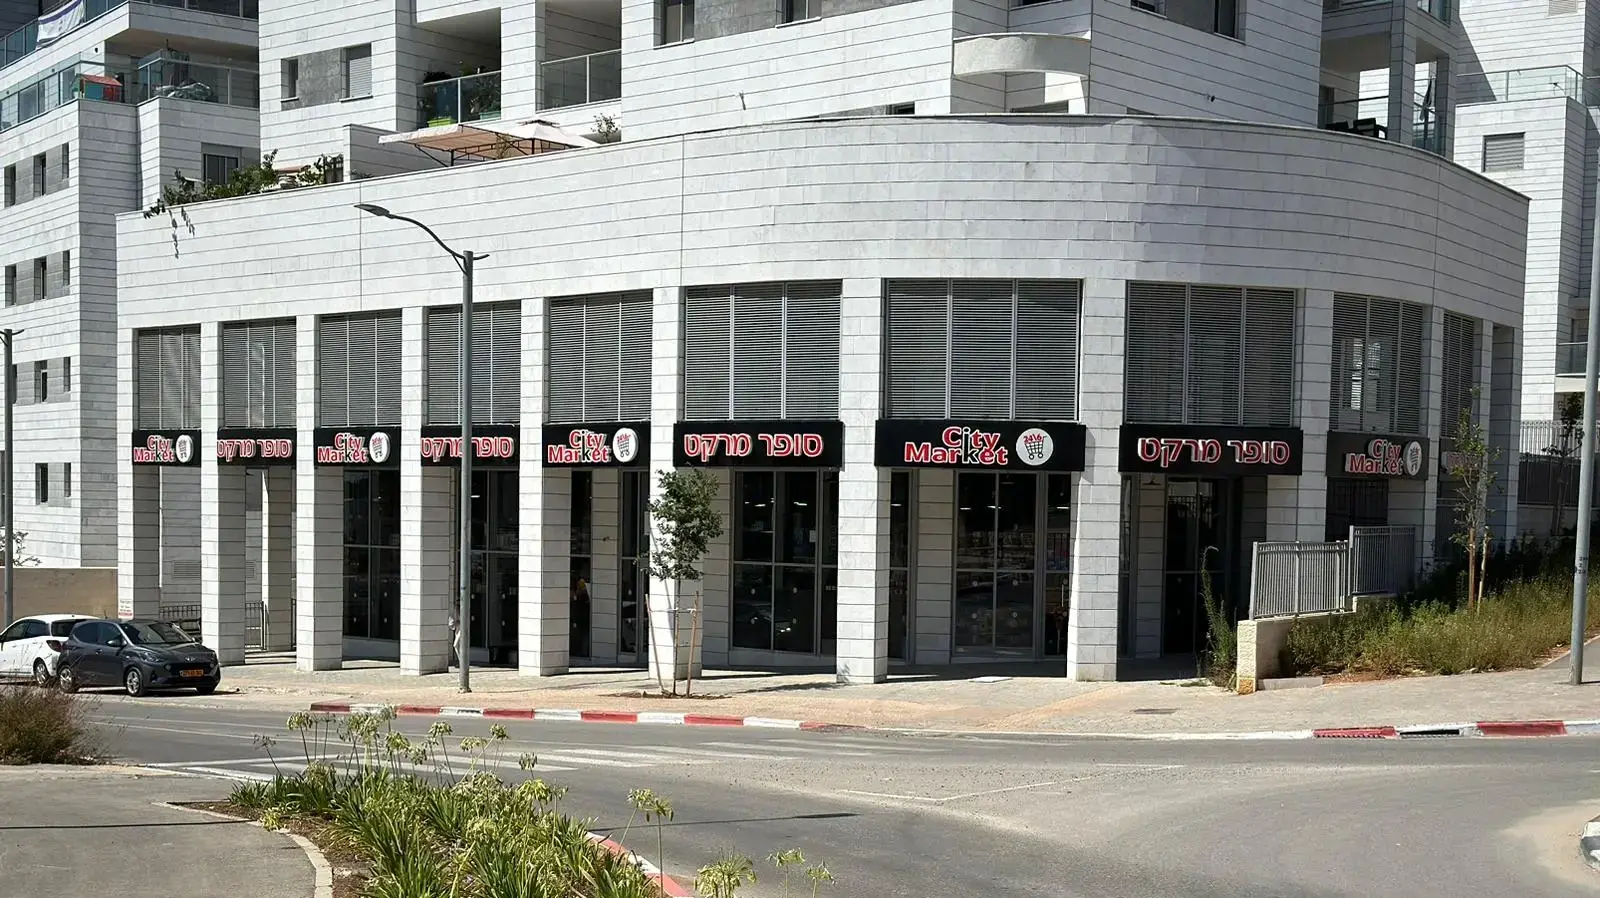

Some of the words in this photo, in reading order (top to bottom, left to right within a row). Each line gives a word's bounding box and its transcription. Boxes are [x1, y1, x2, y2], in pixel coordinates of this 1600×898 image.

[147, 434, 172, 451] City
[256, 438, 292, 458] סופר
[334, 432, 365, 450] City
[471, 436, 514, 458] סופר
[568, 428, 607, 450] City
[683, 433, 752, 463] מרקט
[757, 433, 824, 458] סופר
[941, 426, 1001, 450] City
[1368, 439, 1402, 459] City
[134, 446, 175, 463] Market
[216, 438, 255, 463] מרקט
[317, 445, 369, 463] Market
[547, 444, 611, 463] Market
[903, 441, 1009, 465] Market
[1137, 437, 1222, 469] מרקט
[1226, 439, 1291, 466] סופר
[1345, 452, 1404, 476] Market
